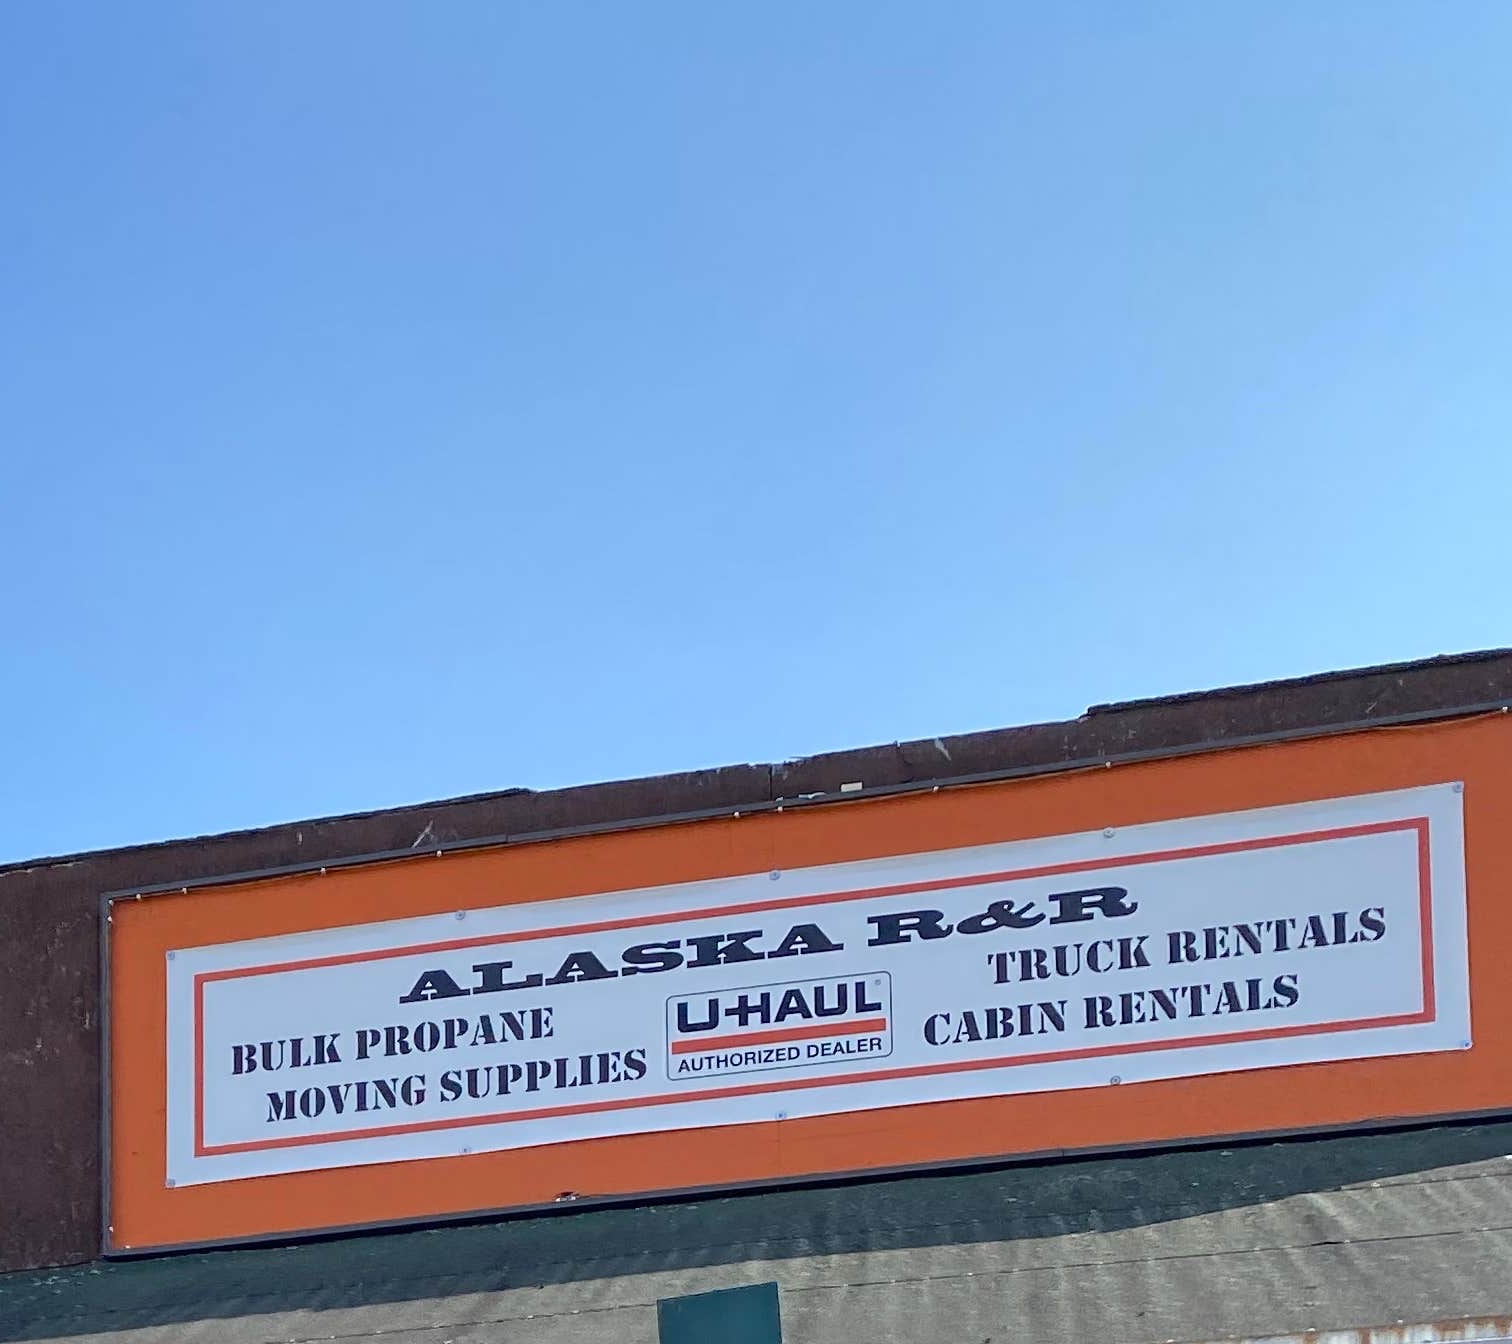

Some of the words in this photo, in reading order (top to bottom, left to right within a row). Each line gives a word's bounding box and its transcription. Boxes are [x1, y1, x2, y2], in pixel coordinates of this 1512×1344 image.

[399, 924, 844, 1004] ALASKA
[868, 886, 1138, 948] R&R
[987, 934, 1151, 985] TRUCK
[1167, 907, 1387, 964] RENTALS
[232, 1032, 341, 1075] BULK
[356, 1007, 555, 1061] PROPANE
[677, 981, 882, 1033] U-HAUL
[924, 997, 1066, 1047] CABIN
[1083, 973, 1300, 1029] RENTALS
[266, 1072, 427, 1123] MOVING
[439, 1048, 647, 1103] SUPPLIES
[678, 1046, 800, 1073] AUTHORIZED
[807, 1037, 882, 1058] DEALER
